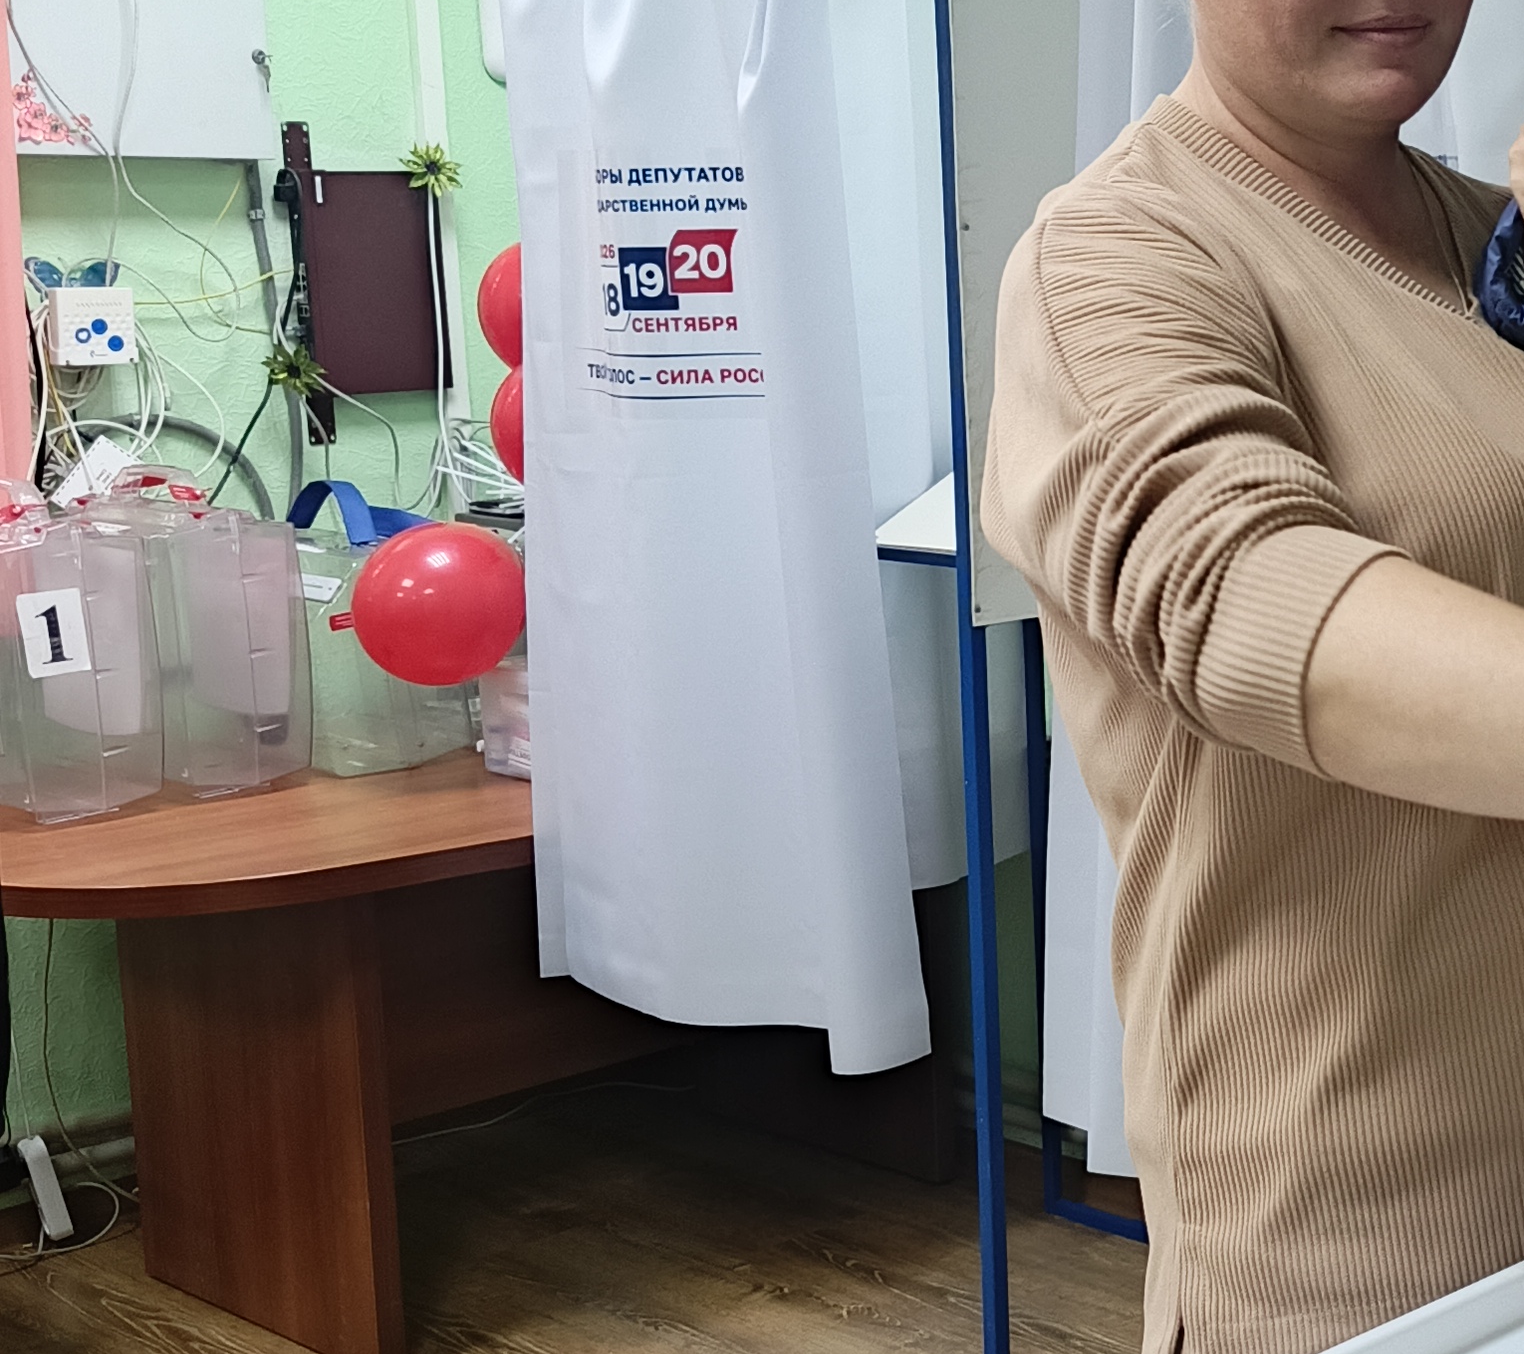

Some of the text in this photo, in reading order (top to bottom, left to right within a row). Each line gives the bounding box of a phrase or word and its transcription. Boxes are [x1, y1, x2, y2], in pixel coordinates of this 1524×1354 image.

[627, 166, 745, 186] ДЕПУТАТОВ
[623, 262, 664, 298] 19
[672, 244, 727, 279] 20
[631, 316, 738, 333] СЕНТЯБРЯ
[656, 368, 714, 385] СИЛА
[35, 604, 74, 665] 1
